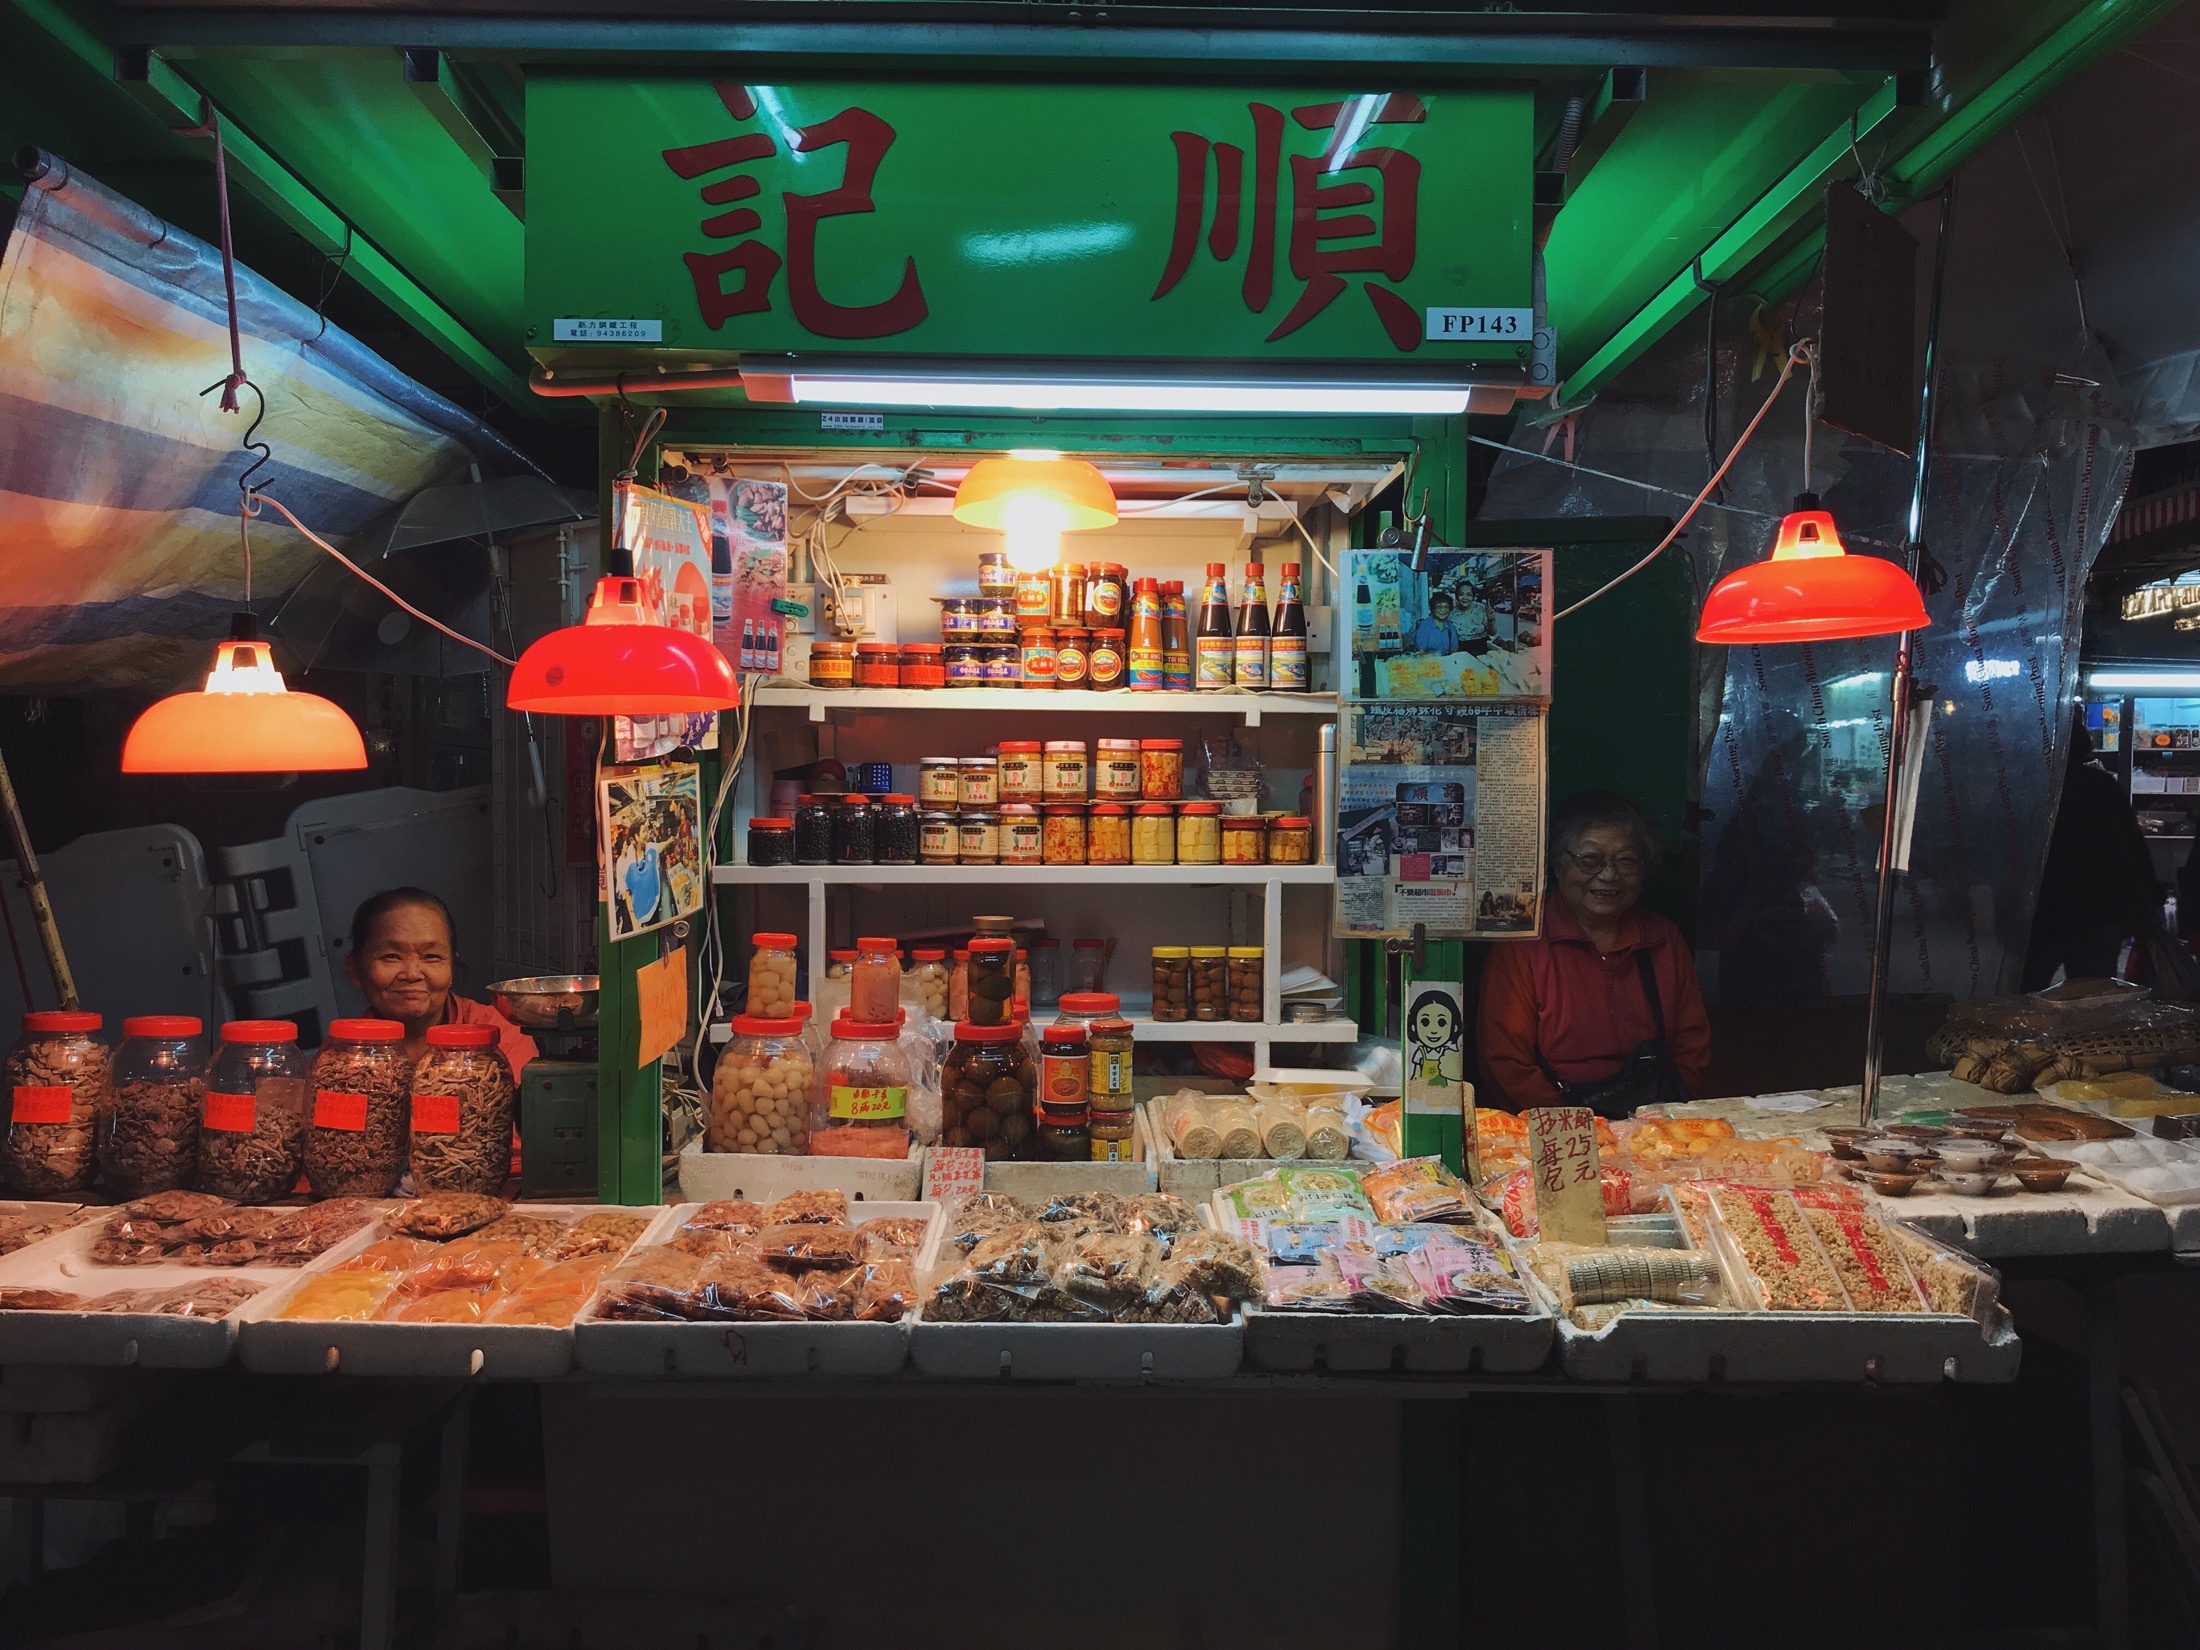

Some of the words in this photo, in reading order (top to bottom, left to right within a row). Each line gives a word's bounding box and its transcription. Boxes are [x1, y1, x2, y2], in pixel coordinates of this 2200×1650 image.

[1442, 315, 1517, 334] FP143
[2078, 486, 2091, 524] China
[2007, 561, 2023, 597] South
[1754, 657, 1768, 692] South
[1801, 644, 1818, 683] Mornin
[1809, 685, 1826, 717] China
